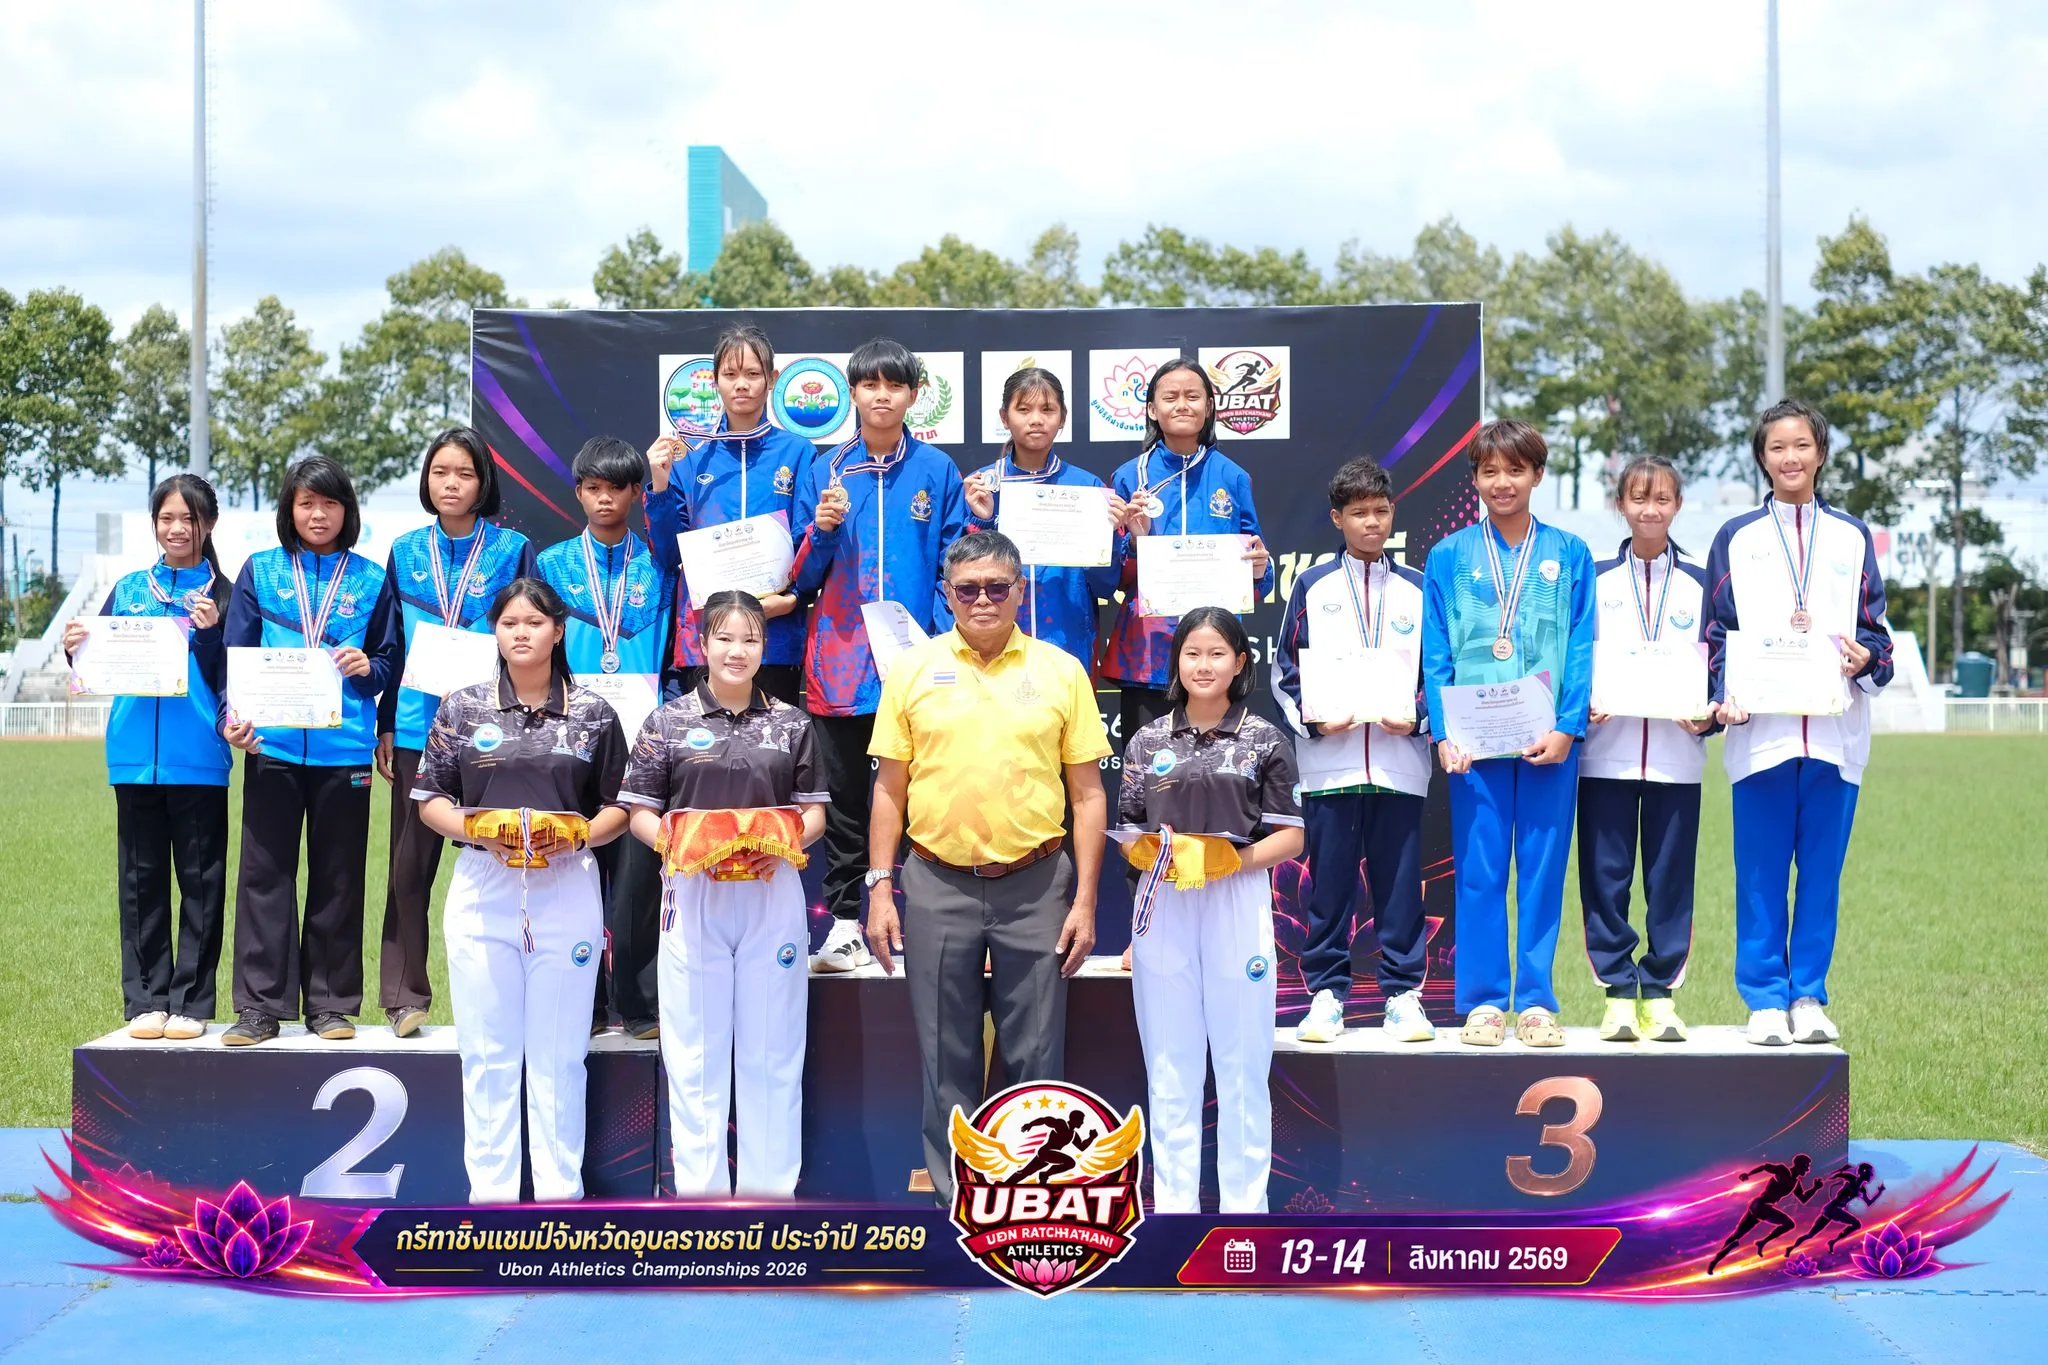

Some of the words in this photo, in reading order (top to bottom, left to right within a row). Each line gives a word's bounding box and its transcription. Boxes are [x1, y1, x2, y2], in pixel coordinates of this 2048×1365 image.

[1214, 394, 1276, 411] UBAT
[299, 1066, 409, 1199] 2
[1505, 1076, 1603, 1197] 3
